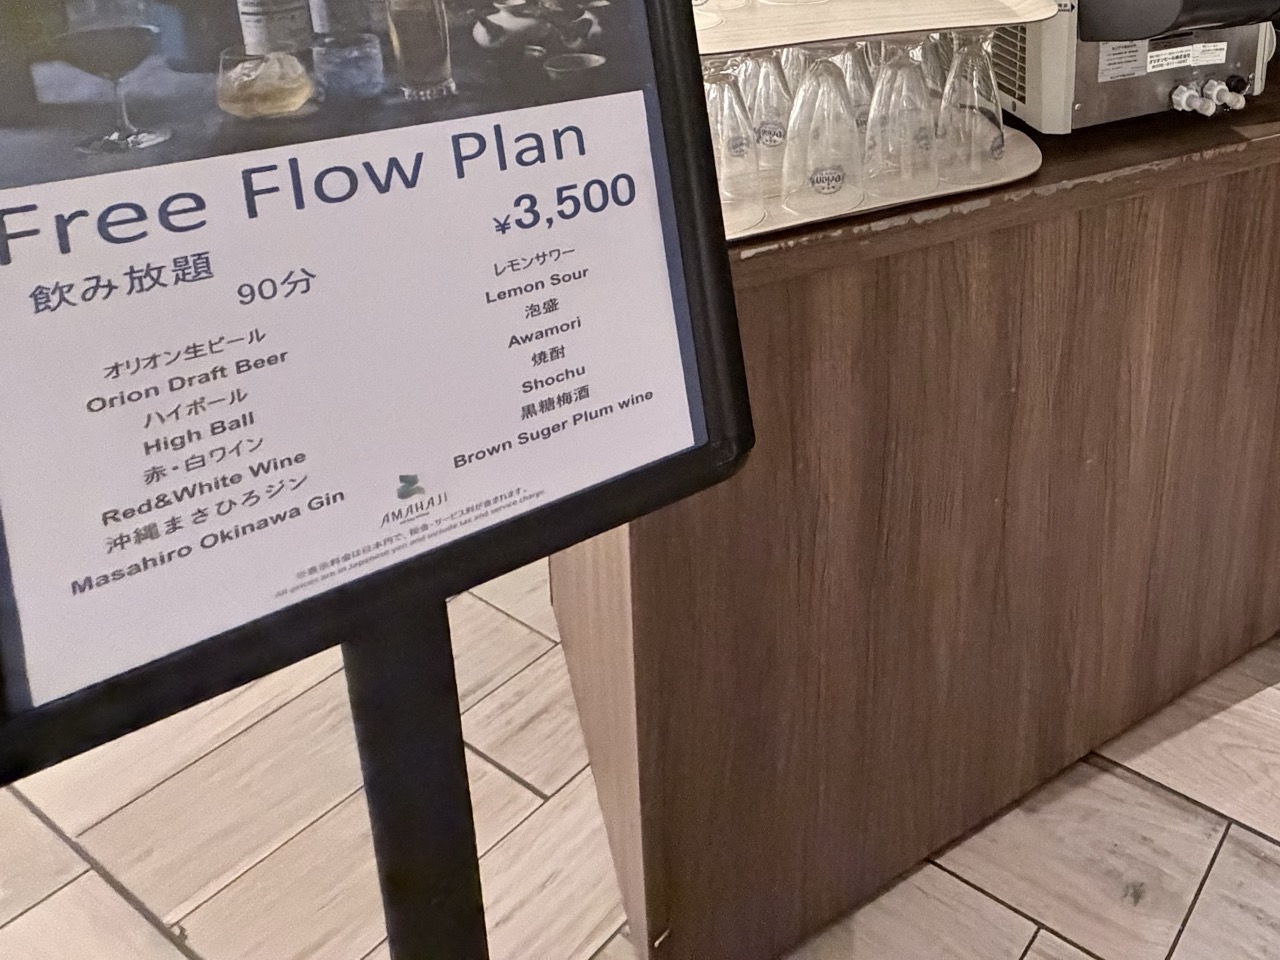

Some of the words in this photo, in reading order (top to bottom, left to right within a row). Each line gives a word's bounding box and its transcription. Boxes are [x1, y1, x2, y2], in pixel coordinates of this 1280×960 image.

[0, 191, 207, 266] Free
[242, 152, 424, 219] Flow
[451, 123, 587, 179] Plan
[493, 173, 636, 235] ¥3,500
[28, 251, 215, 315] 飲み放題
[493, 247, 576, 277] レモンサワー
[236, 267, 317, 306] 90分
[485, 279, 546, 304] Lemon
[549, 266, 589, 287] Sour
[524, 297, 560, 319] 泡盛
[103, 327, 266, 380] オリオン生ビール
[508, 316, 582, 349] Awamori
[531, 345, 566, 367] 焼酎
[86, 385, 160, 414] Orion
[168, 365, 229, 393] Draft
[235, 351, 289, 375] Beer
[521, 365, 587, 394] Shochu
[144, 388, 248, 429] ハイボール
[520, 384, 591, 421] 黒糖梅酒
[144, 430, 202, 457] High
[210, 411, 255, 437] Ball
[453, 440, 513, 470] Brown
[517, 418, 569, 447] Suger
[572, 404, 615, 427] Plum
[617, 389, 654, 410] wine
[102, 472, 243, 526] Red&White
[249, 451, 307, 478] Wine
[379, 491, 448, 528] AMAHAJI
[106, 475, 308, 555] 沖縄まさひろジン
[71, 544, 193, 596] Masahiro
[200, 505, 302, 549] Okinawa
[307, 489, 346, 512] Gin
